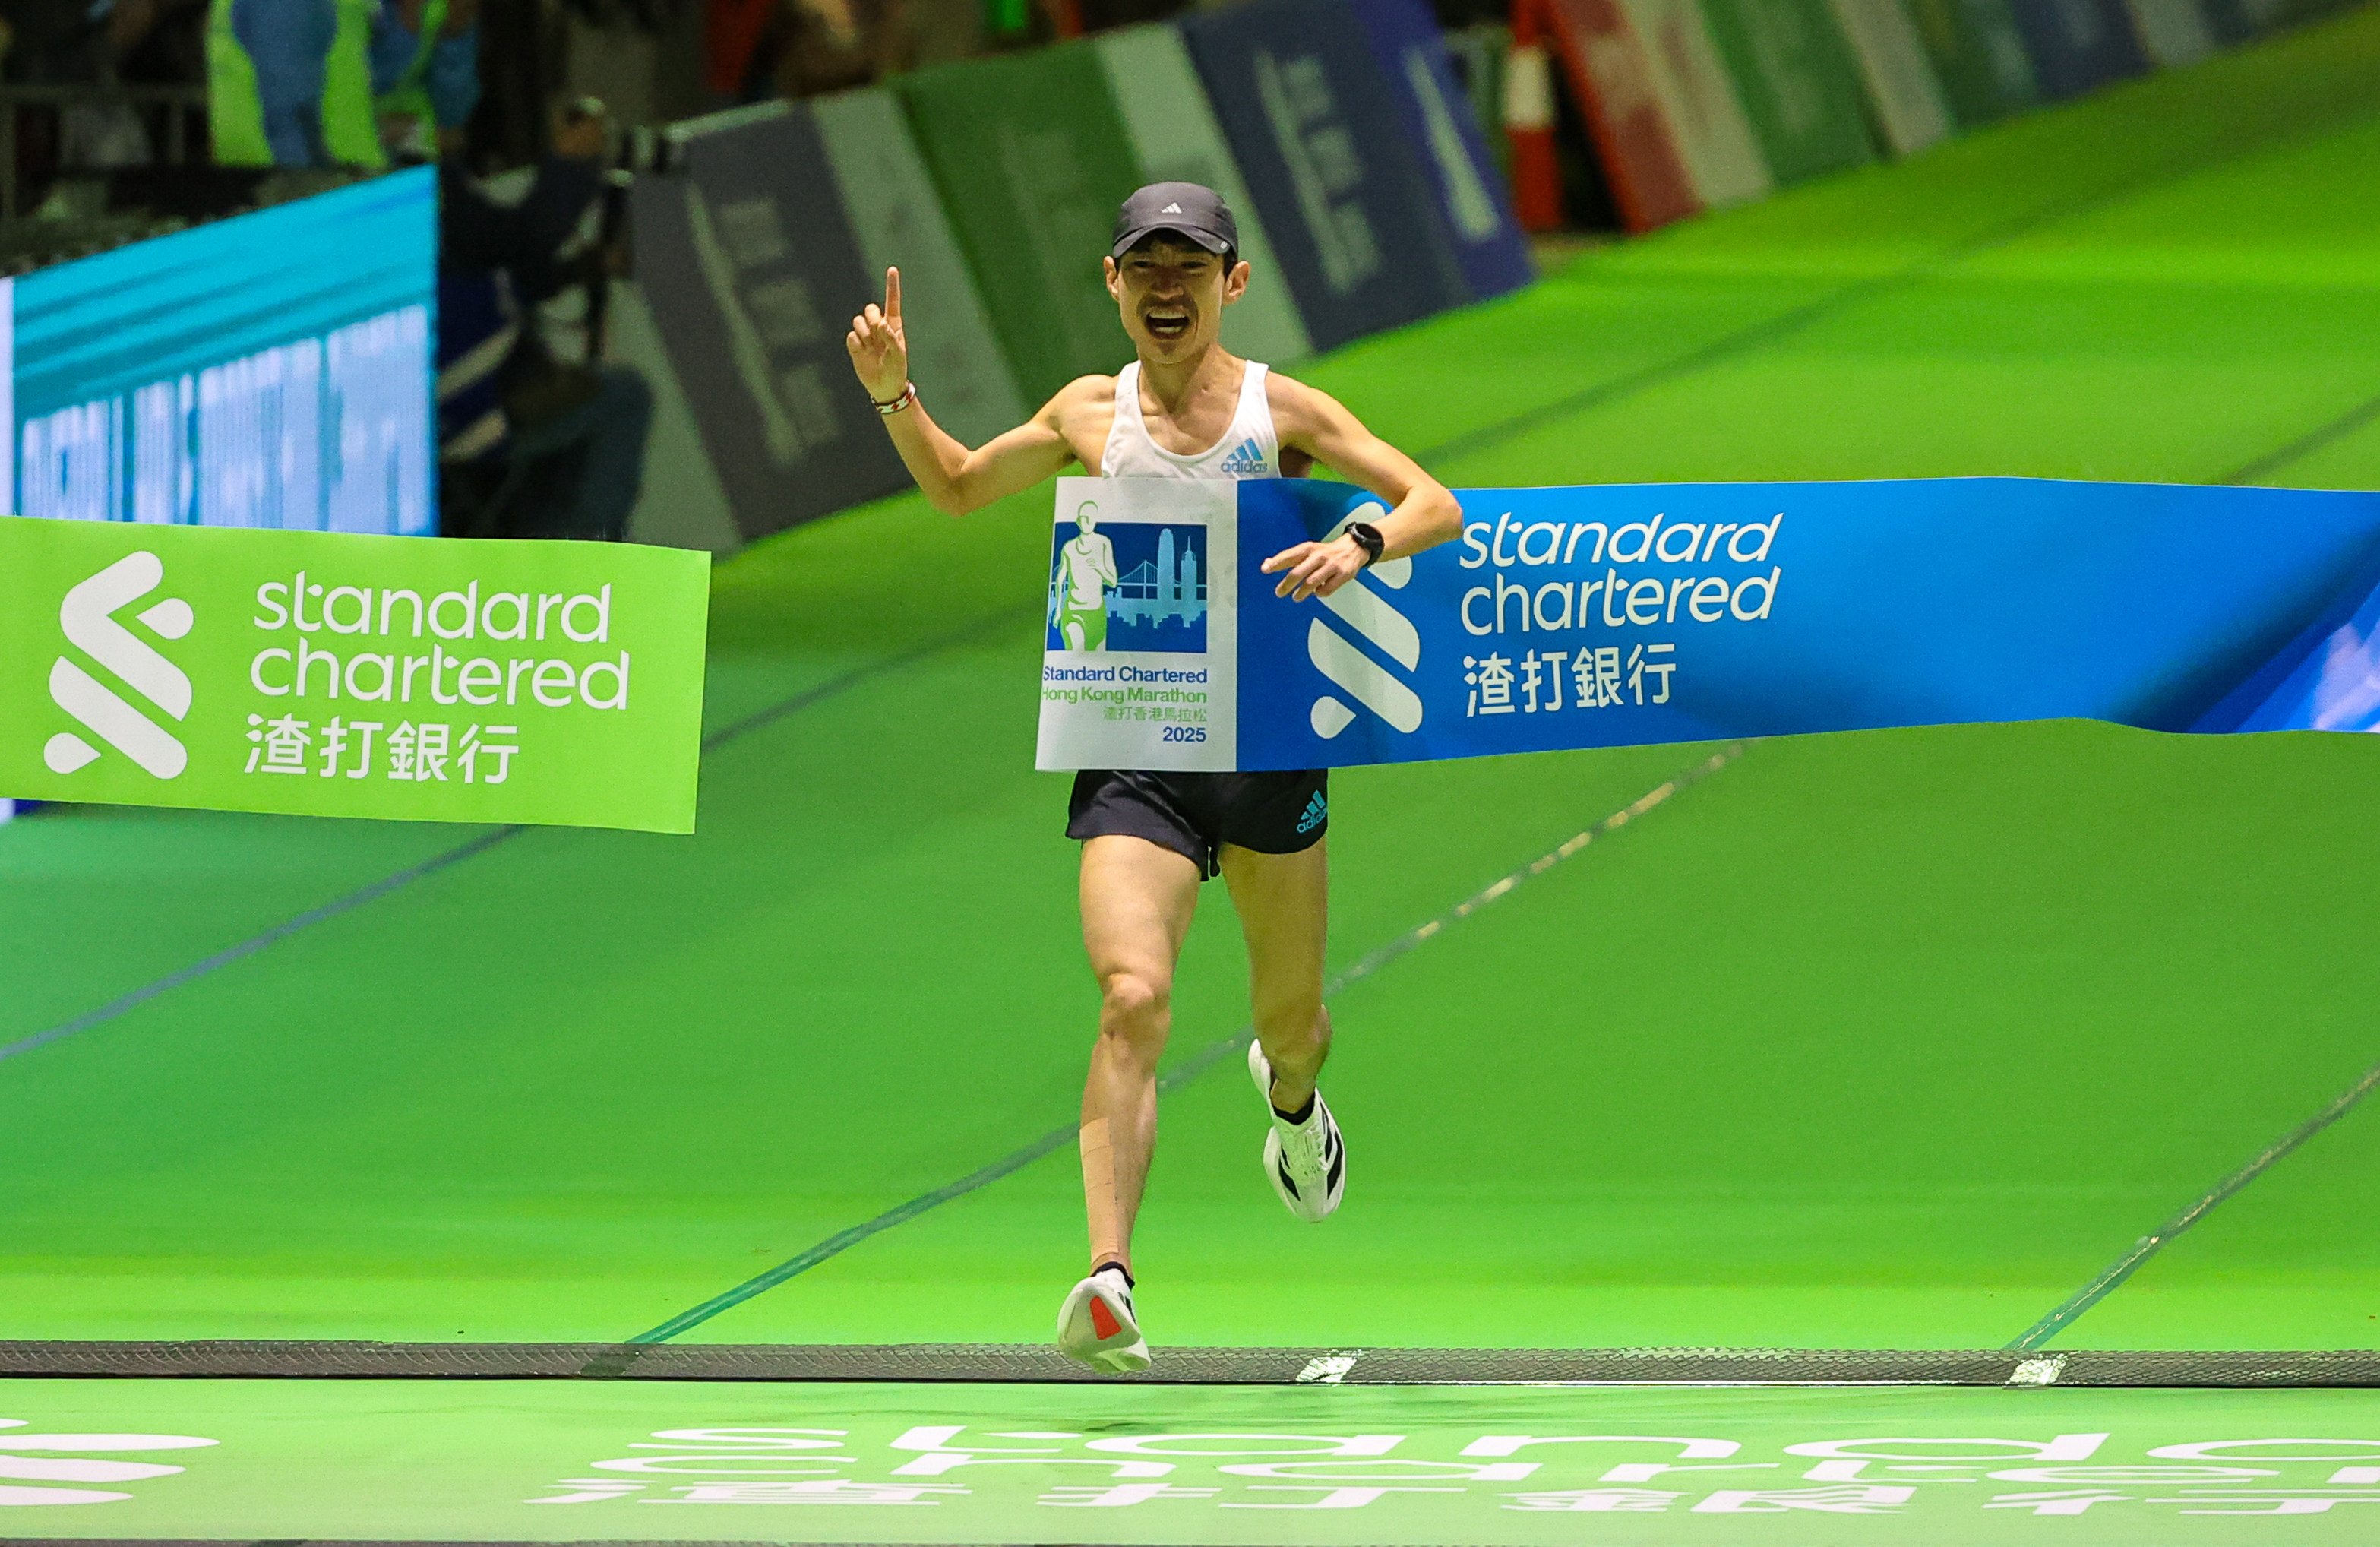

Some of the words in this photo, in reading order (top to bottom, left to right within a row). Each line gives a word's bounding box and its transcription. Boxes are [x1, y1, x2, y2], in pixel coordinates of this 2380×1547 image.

[1221, 460, 1268, 473] adidas
[1459, 511, 1784, 568] standard
[253, 570, 611, 643] standard
[1461, 565, 1781, 635] chartered
[249, 637, 631, 710] chartered
[1041, 686, 1077, 704] Hong
[1081, 686, 1124, 704] Kong
[1127, 687, 1207, 703] Marathon
[1043, 666, 1114, 682] Standard
[1119, 666, 1208, 683] Chartered
[1463, 644, 1676, 718] 渣打銀行
[1103, 706, 1207, 722] 渣打香港馬拉松
[1162, 726, 1206, 742] 2025
[244, 713, 520, 784] 渣打銀行
